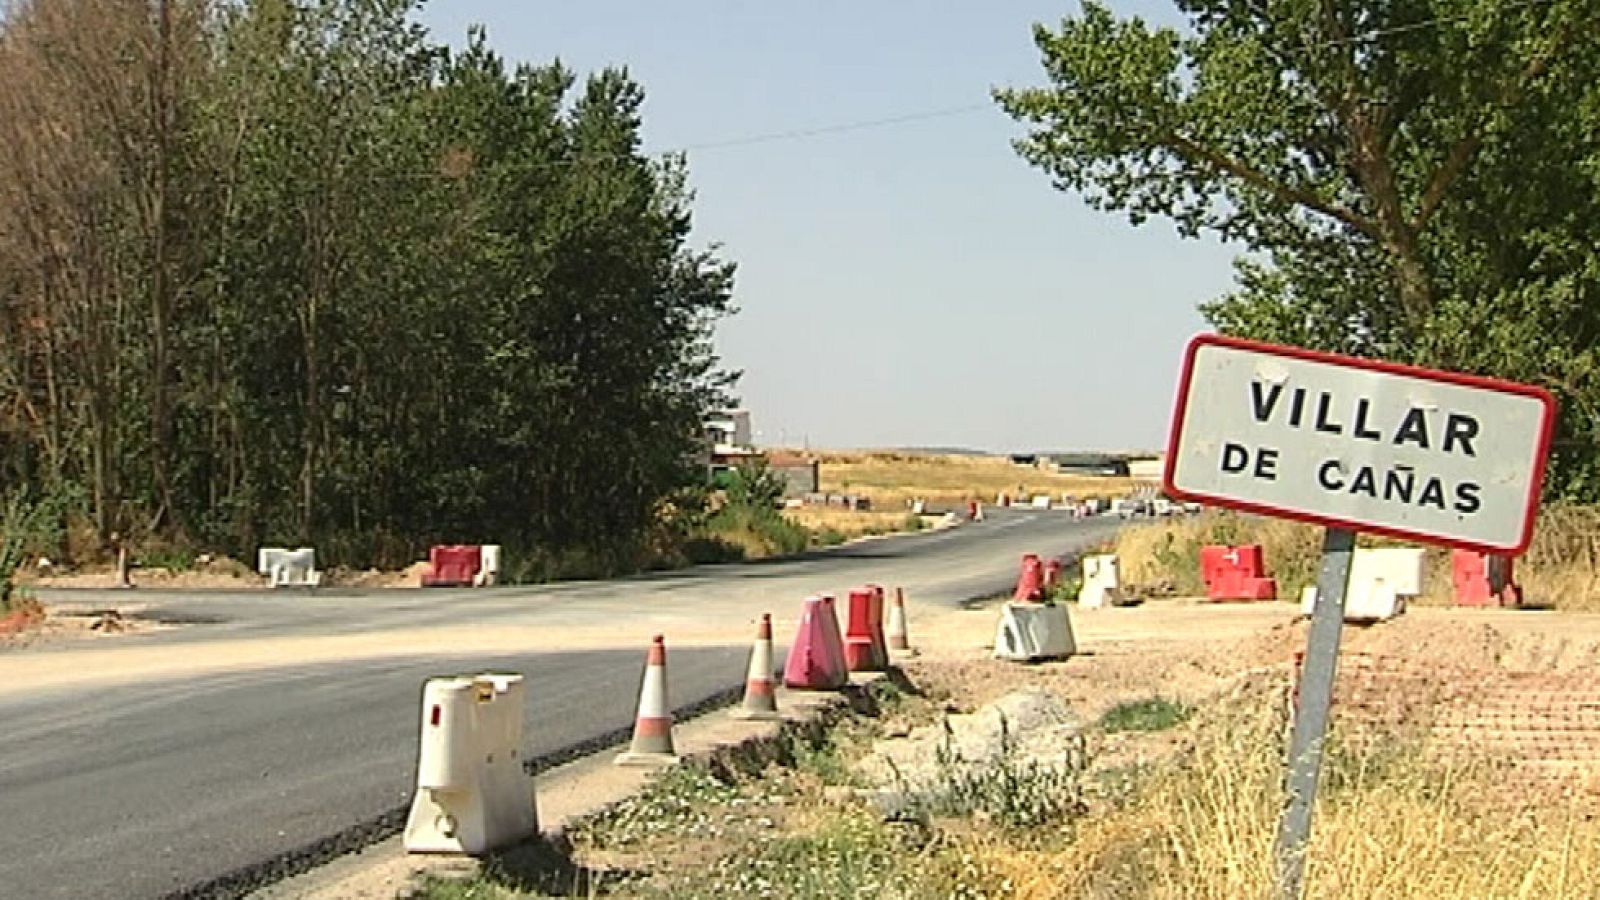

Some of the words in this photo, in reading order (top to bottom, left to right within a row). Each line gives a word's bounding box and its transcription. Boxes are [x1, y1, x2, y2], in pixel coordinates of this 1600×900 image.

[1251, 381, 1480, 457] VILLAR
[1221, 442, 1280, 480] DE
[1318, 459, 1482, 514] CAÑAS
